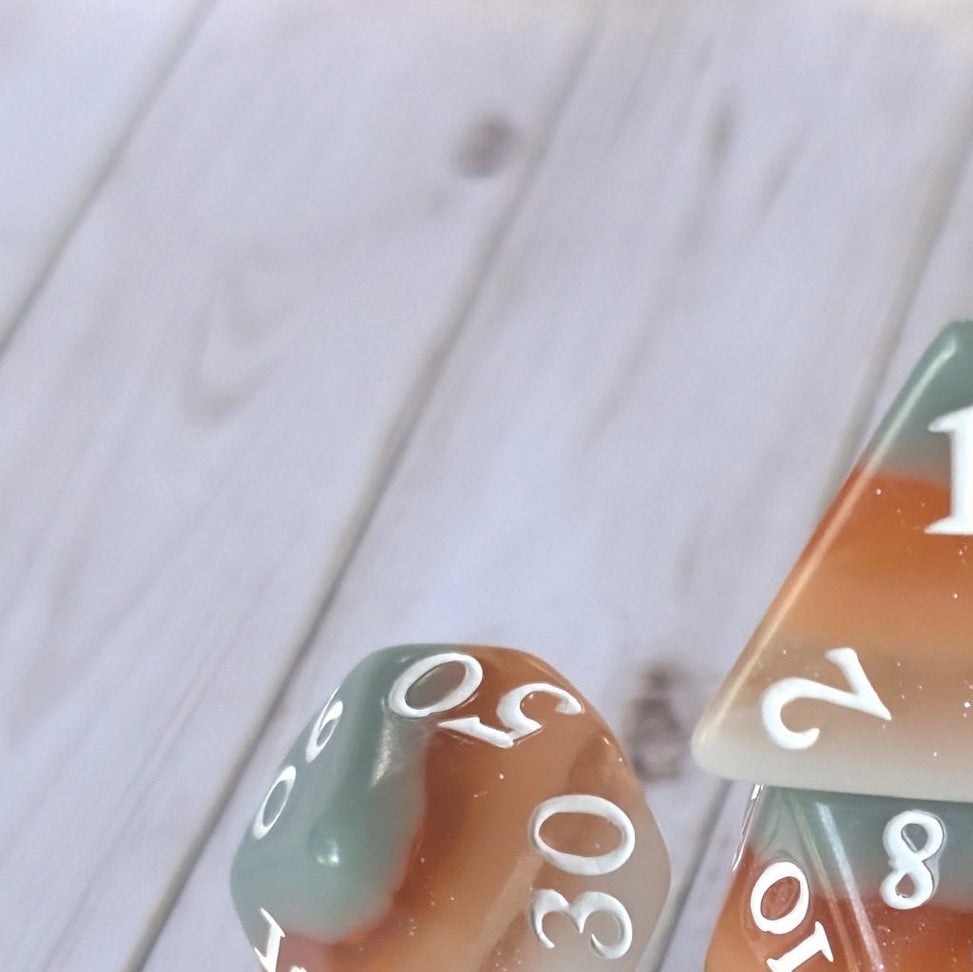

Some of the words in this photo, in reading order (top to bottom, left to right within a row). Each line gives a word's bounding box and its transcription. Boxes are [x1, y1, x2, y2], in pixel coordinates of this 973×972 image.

[387, 651, 583, 748] 50
[761, 647, 892, 750] 2
[529, 794, 636, 960] 30
[880, 810, 945, 910] 8
